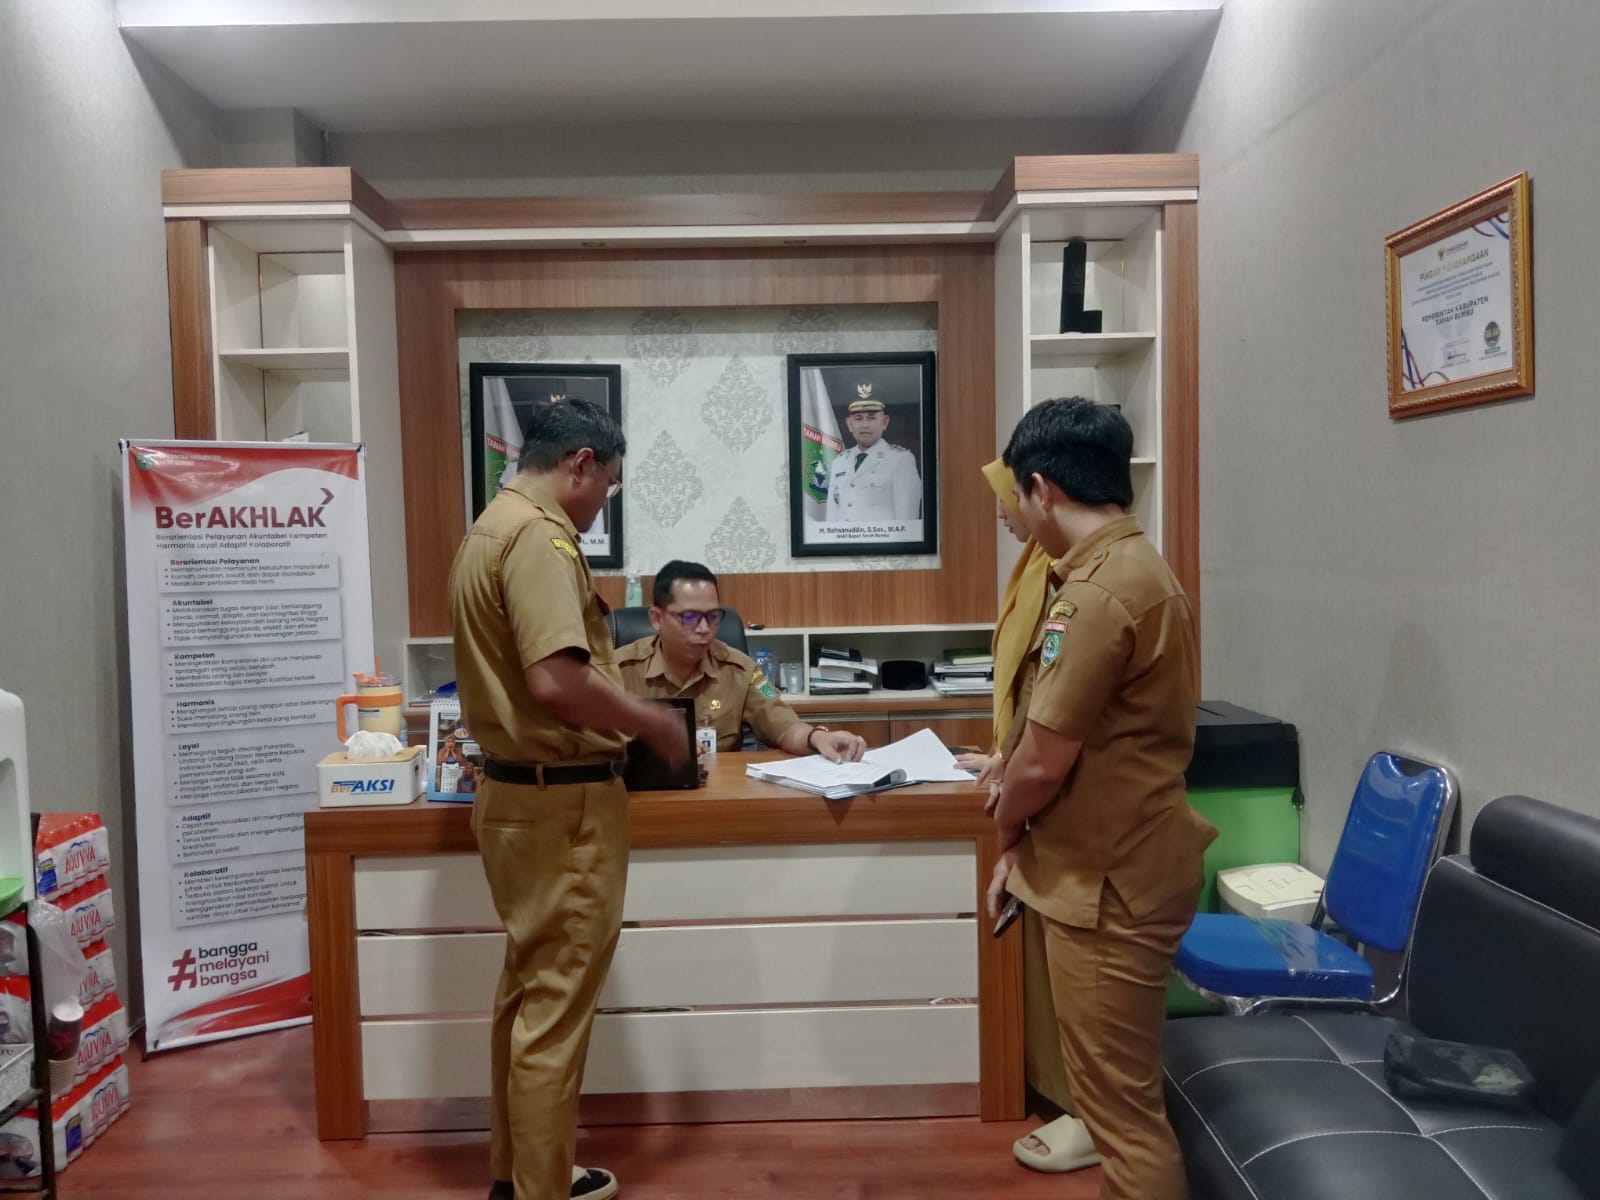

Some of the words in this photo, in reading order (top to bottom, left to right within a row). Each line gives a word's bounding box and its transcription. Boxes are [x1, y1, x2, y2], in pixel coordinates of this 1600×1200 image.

[1455, 309, 1474, 320] BUMBU
[155, 506, 326, 529] BerAKHLAK
[205, 533, 247, 541] Pelayanan
[249, 532, 287, 540] Akuntabel
[170, 558, 217, 566] Berorientasi
[218, 557, 260, 565] Pelayanan
[173, 598, 213, 606] Akuntabel
[175, 652, 215, 661] Kompeten
[176, 700, 215, 708] Harmonis
[178, 743, 199, 752] Loyal
[182, 813, 211, 822] Adaptif
[184, 867, 228, 877] Kolaboratif
[199, 942, 258, 959] bangga
[200, 951, 270, 973] melayani
[200, 969, 257, 986] bangsa
